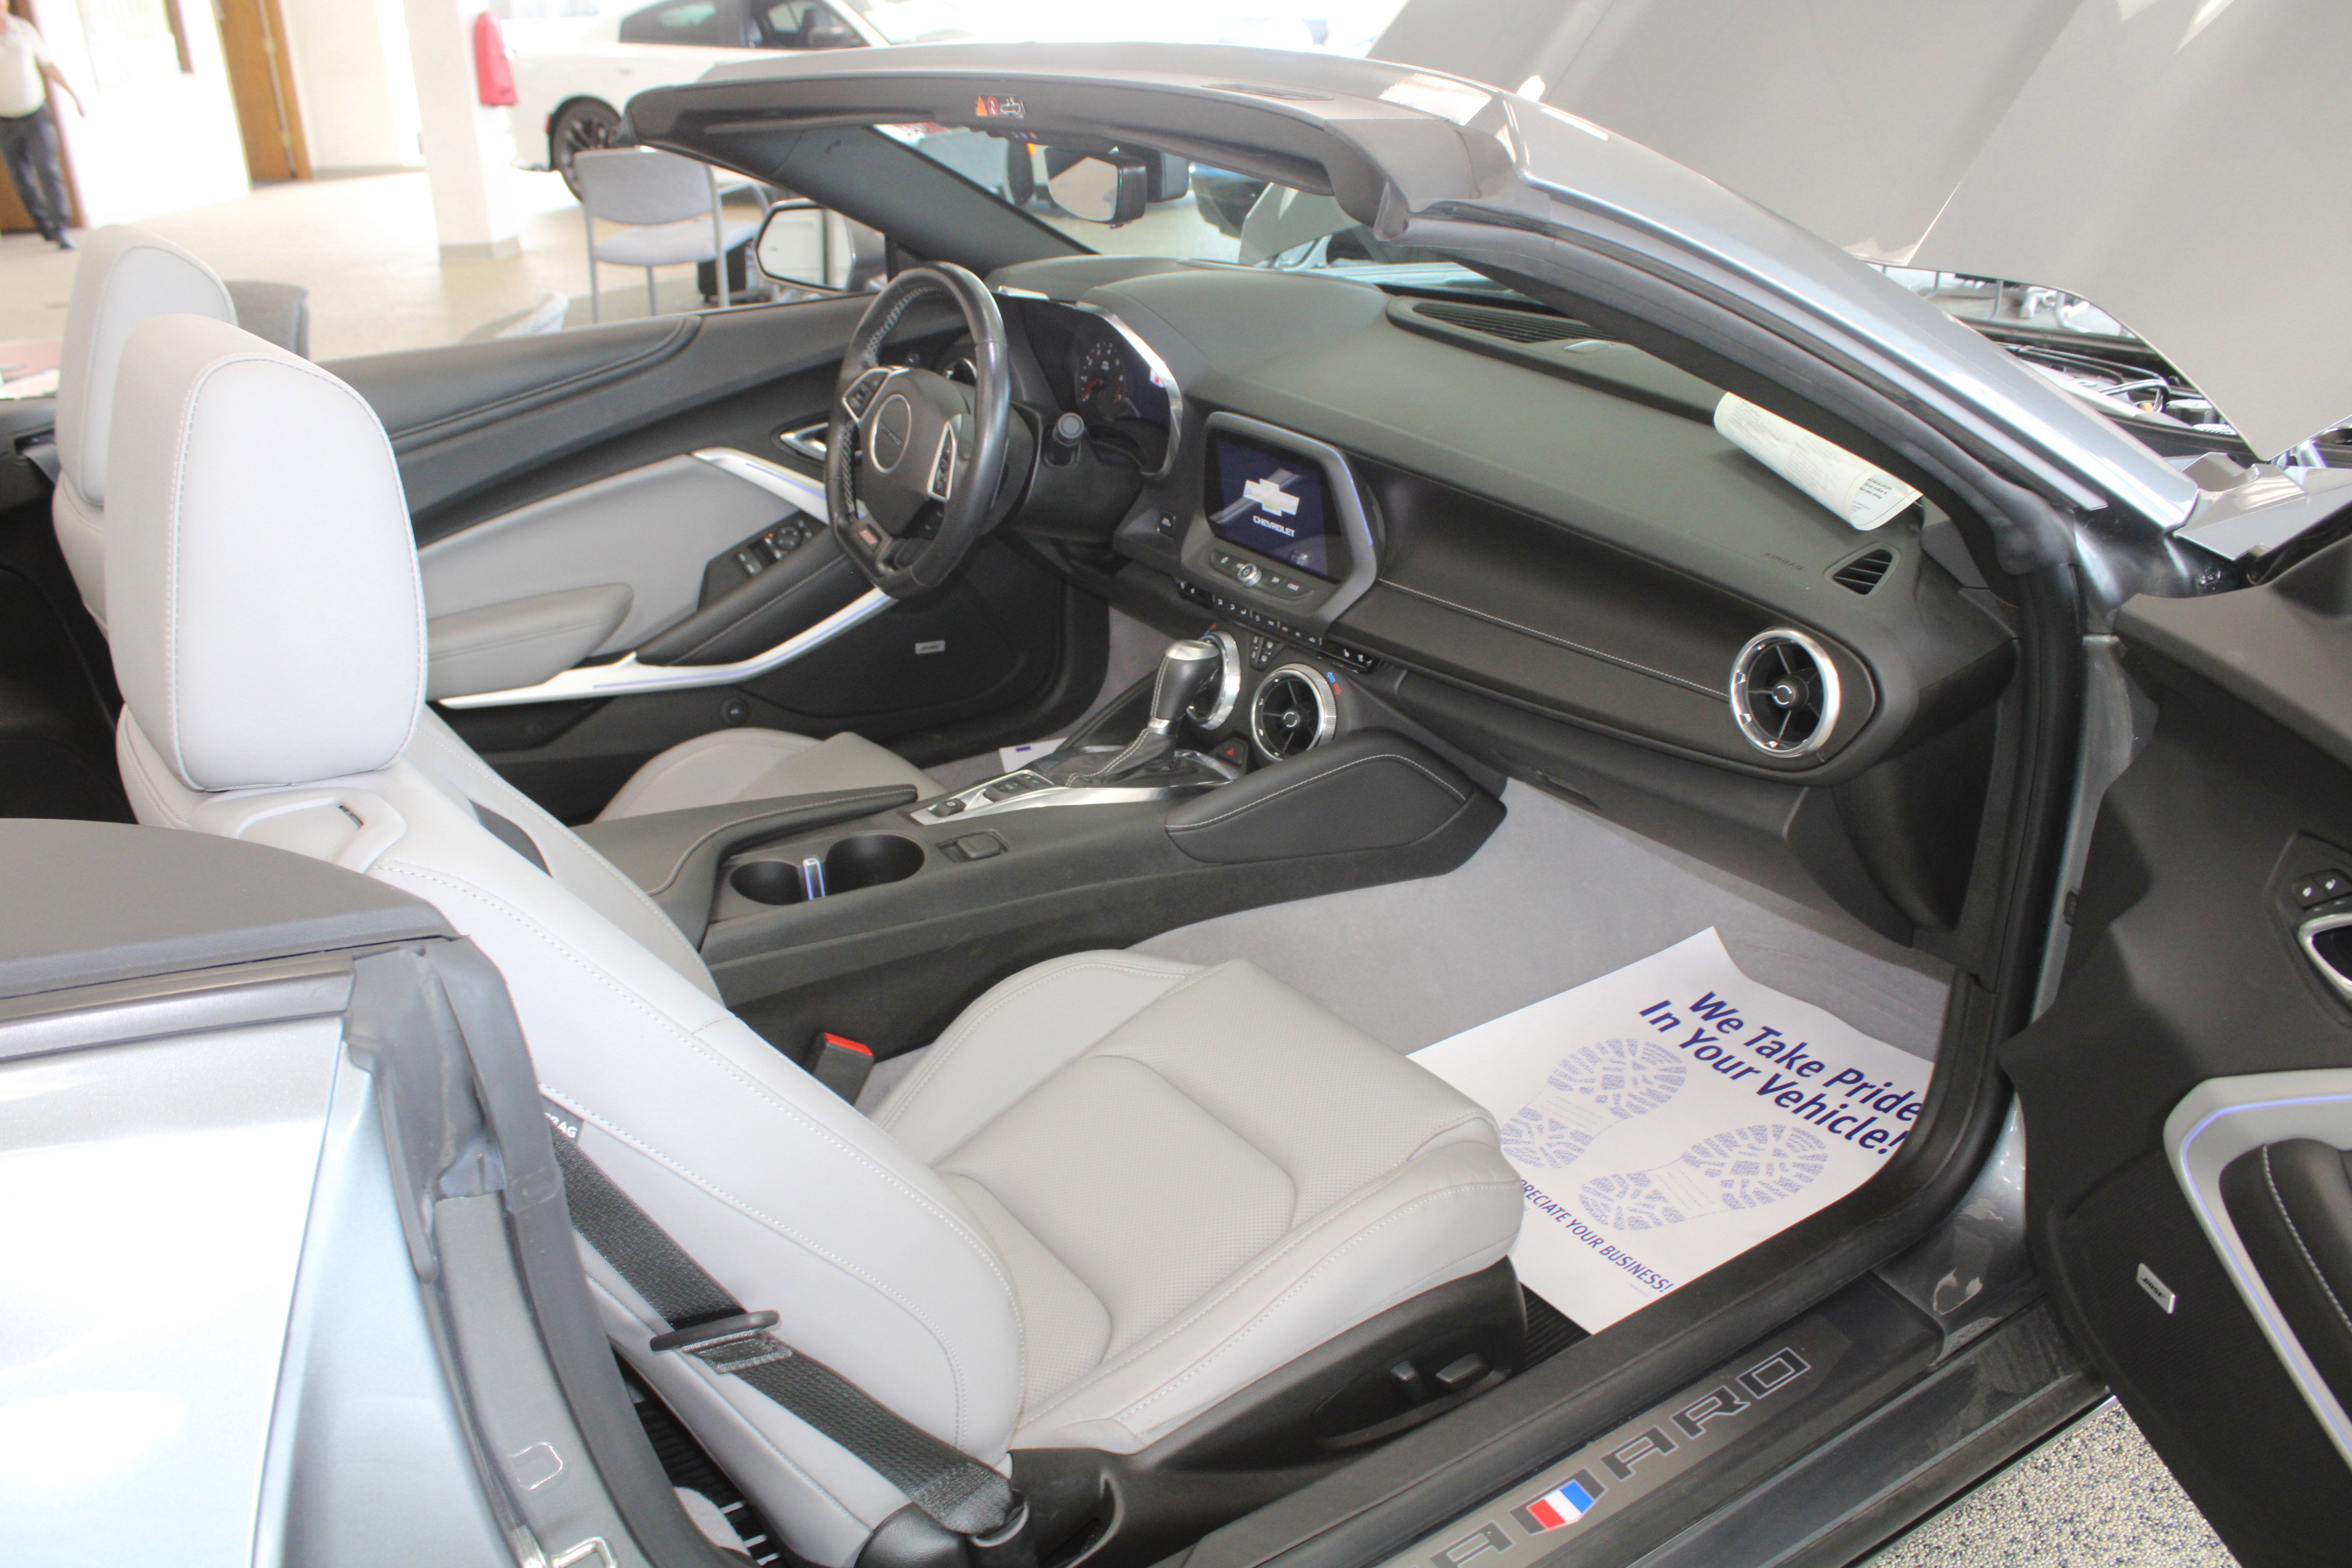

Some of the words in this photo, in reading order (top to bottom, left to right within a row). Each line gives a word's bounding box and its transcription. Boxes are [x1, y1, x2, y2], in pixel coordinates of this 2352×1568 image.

[1253, 515, 1295, 537] CHEVROLET
[1763, 553, 1804, 571] AIRBAG
[1639, 1000, 1681, 1033] In
[1679, 1027, 1762, 1080] Your
[1755, 1073, 1909, 1154] Vehicle!
[1688, 991, 1744, 1034] We
[1743, 1026, 1825, 1078] Take
[1822, 1067, 1923, 1121] Pride
[1565, 1218, 1605, 1248] YOUR
[1598, 1245, 1675, 1293] BUSINESS!
